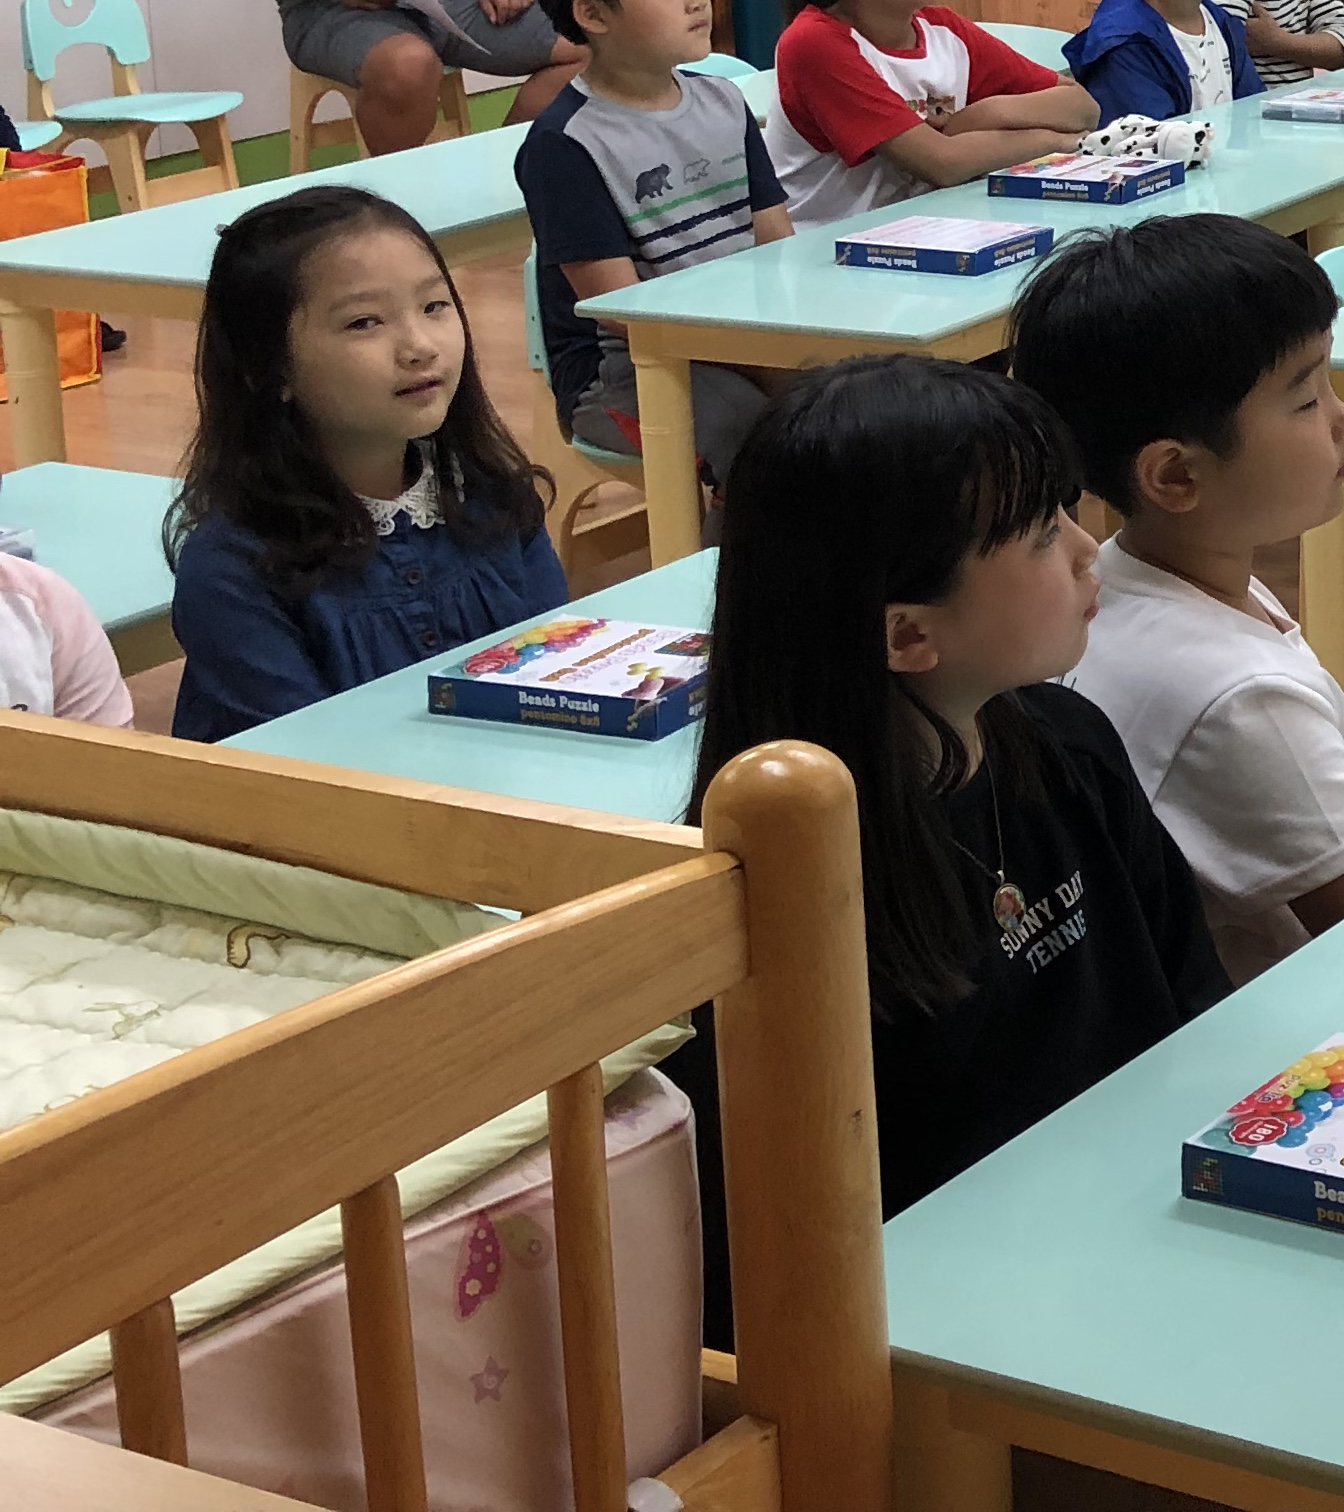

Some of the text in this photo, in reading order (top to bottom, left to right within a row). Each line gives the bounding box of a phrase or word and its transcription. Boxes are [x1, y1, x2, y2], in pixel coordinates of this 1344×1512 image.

[519, 691, 599, 713] Beads Puzzle
[1000, 870, 1084, 960] SUNNY DAY
[1247, 1123, 1279, 1141] 180
